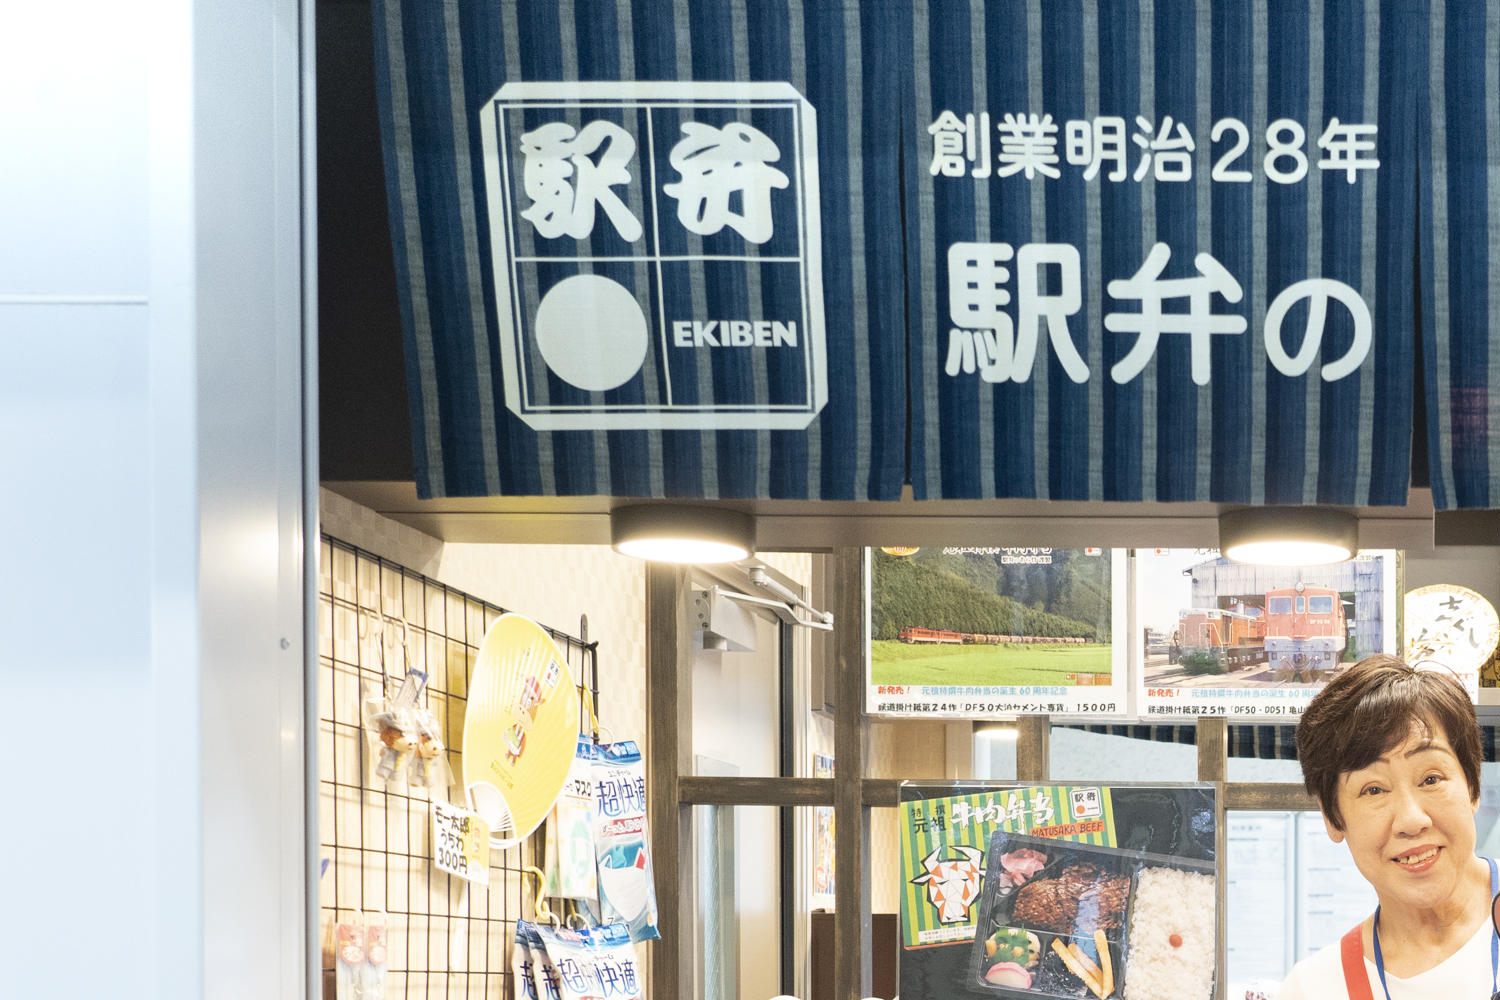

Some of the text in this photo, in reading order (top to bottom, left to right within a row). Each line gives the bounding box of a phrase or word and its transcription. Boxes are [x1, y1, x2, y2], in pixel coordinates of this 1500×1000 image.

[928, 111, 1380, 184] 創業明治28年
[944, 241, 1373, 385] 駅弁の
[673, 320, 798, 348] EKIBEN
[950, 792, 1056, 835] 牛肉弁当
[1079, 821, 1103, 832] BEEF
[438, 847, 469, 876] 300円
[557, 957, 640, 998] 超快適
